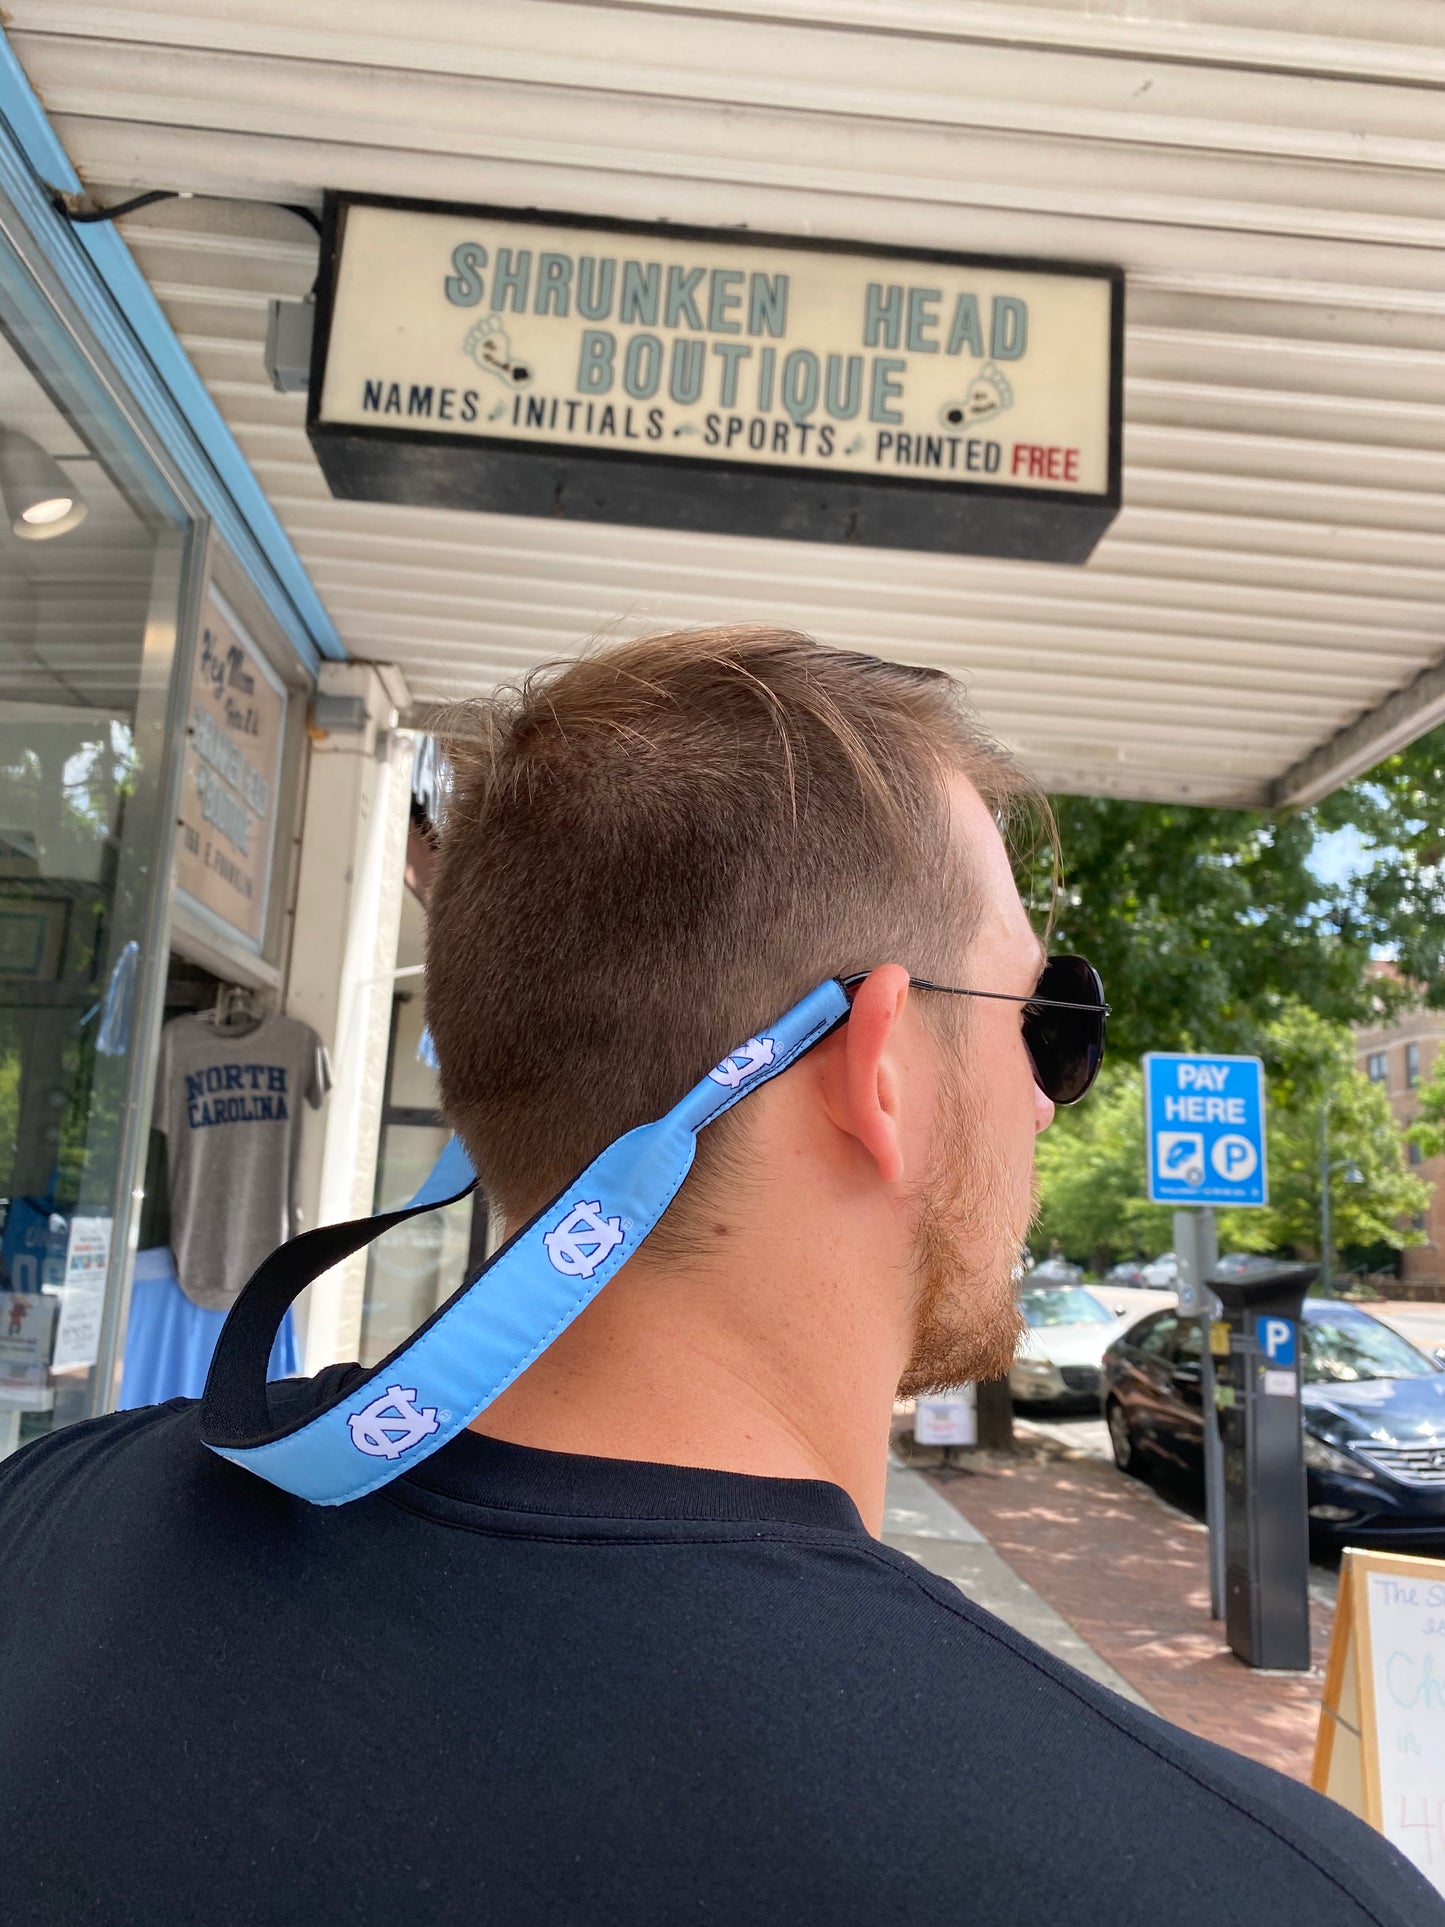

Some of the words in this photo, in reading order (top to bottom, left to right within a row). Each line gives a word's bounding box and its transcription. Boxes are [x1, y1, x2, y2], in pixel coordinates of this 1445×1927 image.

[444, 242, 790, 338] SHRUNKEN
[864, 282, 1028, 361] HEAD
[577, 329, 906, 425] BOUTIQUE
[362, 380, 479, 421] NAMES
[513, 395, 664, 439] INITIALS
[704, 414, 836, 457] SPORTS
[876, 431, 1003, 473] PRINTED
[1012, 444, 1080, 481] FREE
[185, 1064, 287, 1101] NORTH
[1177, 1063, 1230, 1091] PAY
[188, 1095, 288, 1128] CAROLINA
[1164, 1095, 1246, 1125] HERE
[1226, 1141, 1248, 1173] P
[1266, 1320, 1290, 1358] P
[1373, 1580, 1420, 1606] The
